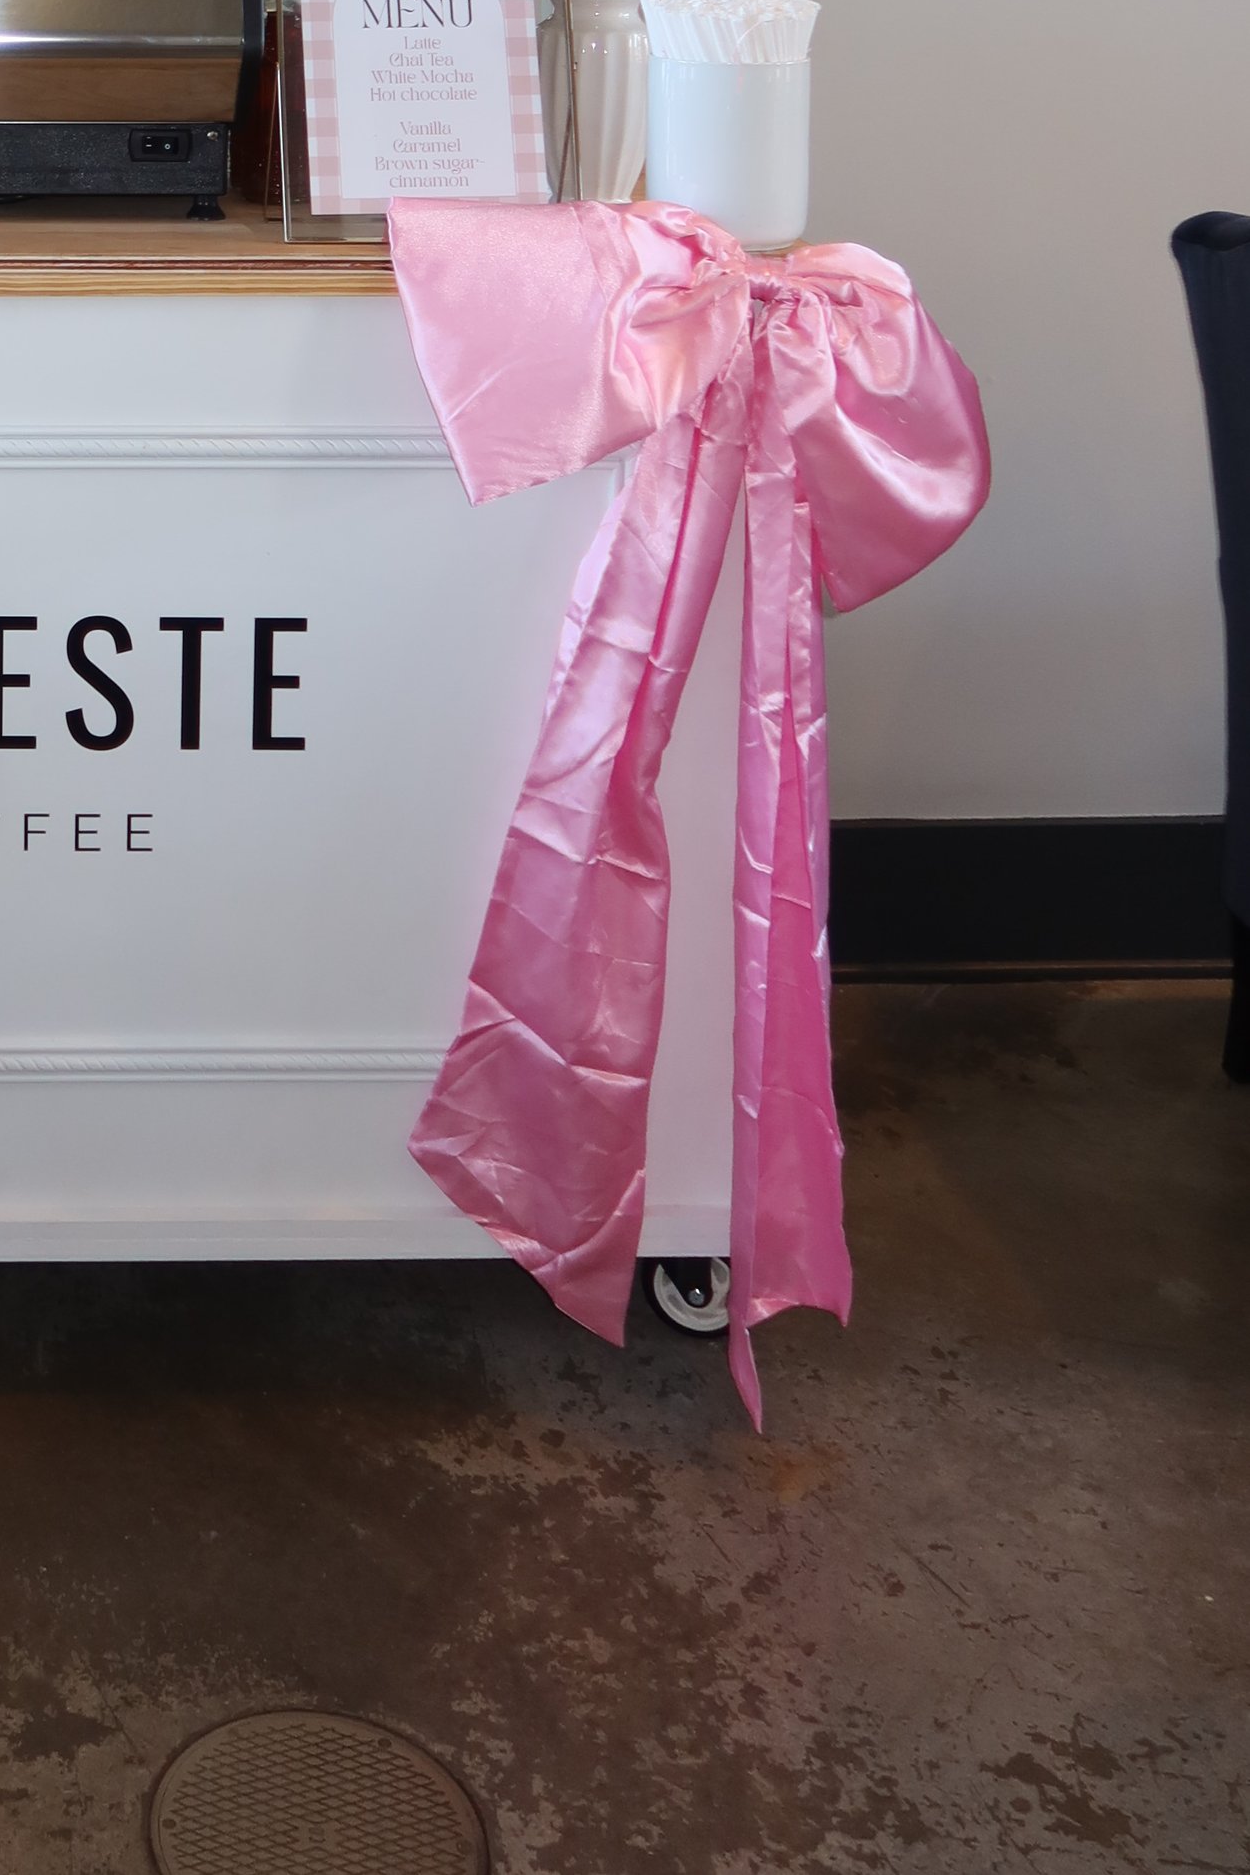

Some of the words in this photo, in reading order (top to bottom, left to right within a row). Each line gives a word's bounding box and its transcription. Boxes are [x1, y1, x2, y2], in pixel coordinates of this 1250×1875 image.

[404, 36, 441, 50] Latte
[389, 53, 423, 67] Chai
[427, 53, 454, 66] Tea
[371, 70, 416, 84] White
[421, 69, 474, 83] Mocha
[370, 88, 396, 102] Hot
[400, 87, 478, 101] chocolate
[400, 121, 451, 135] Vanilla
[393, 138, 461, 153] Caramel
[375, 157, 428, 171] Brown
[389, 175, 469, 188] cinnamon
